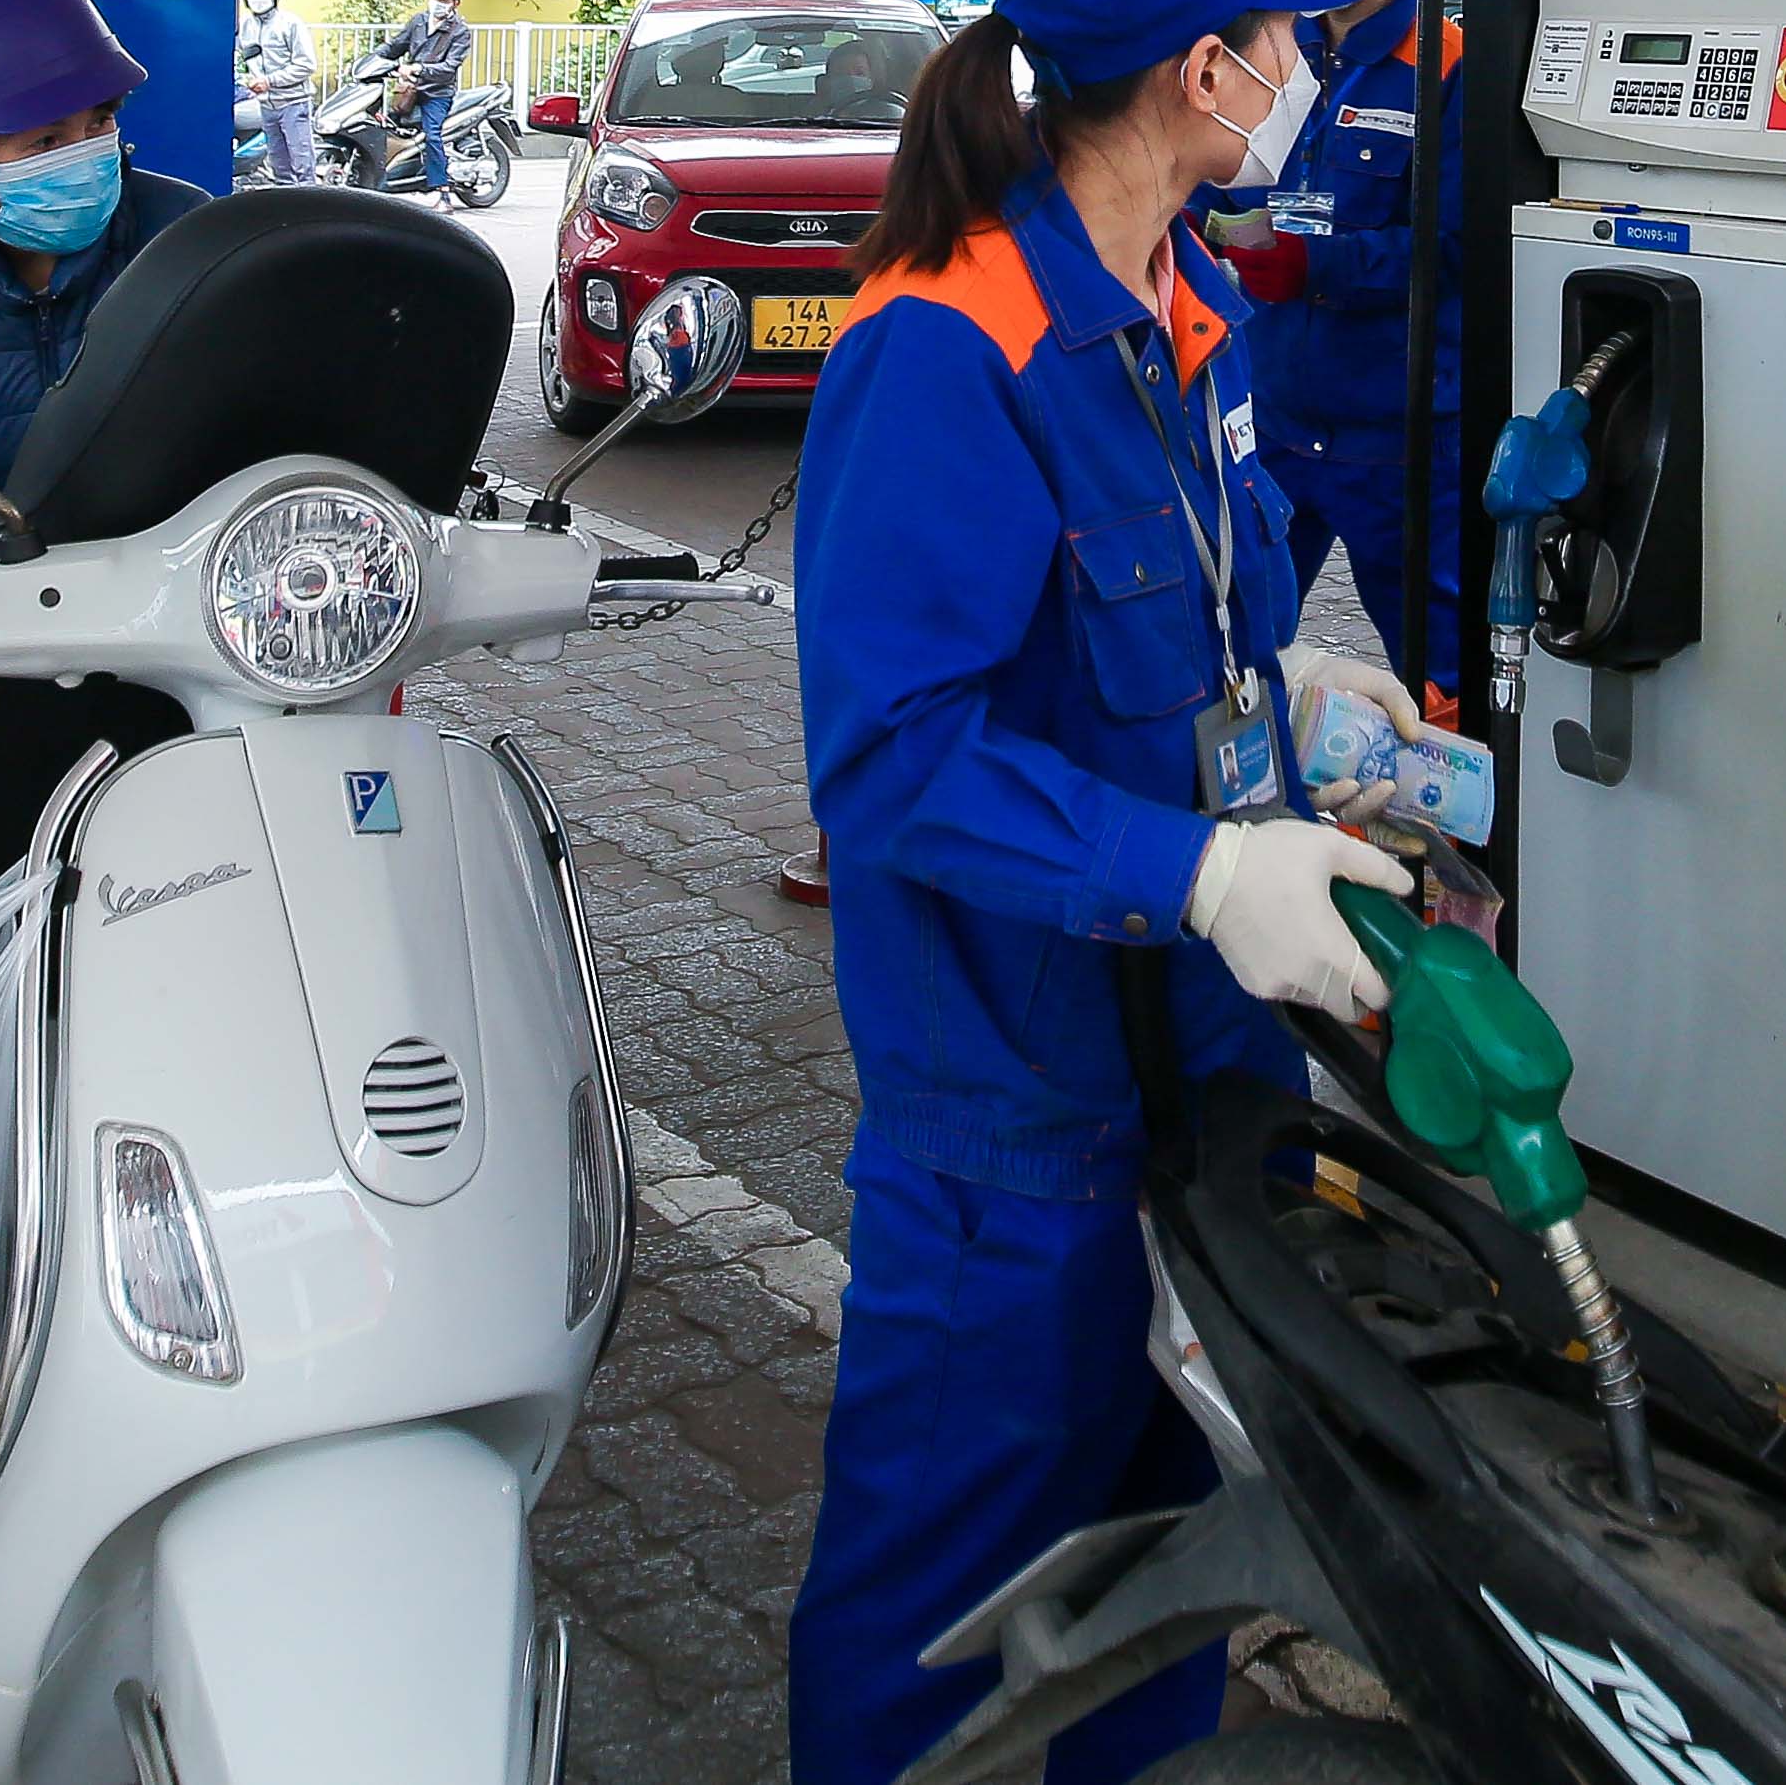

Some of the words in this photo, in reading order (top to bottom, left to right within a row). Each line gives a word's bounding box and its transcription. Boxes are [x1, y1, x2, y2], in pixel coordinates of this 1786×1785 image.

[795, 220, 823, 233] KIA
[1626, 224, 1678, 244] RON95-III
[787, 300, 829, 323] 14A
[764, 325, 840, 349] 427.2
[348, 774, 377, 811] P
[97, 861, 253, 927] Vespa
